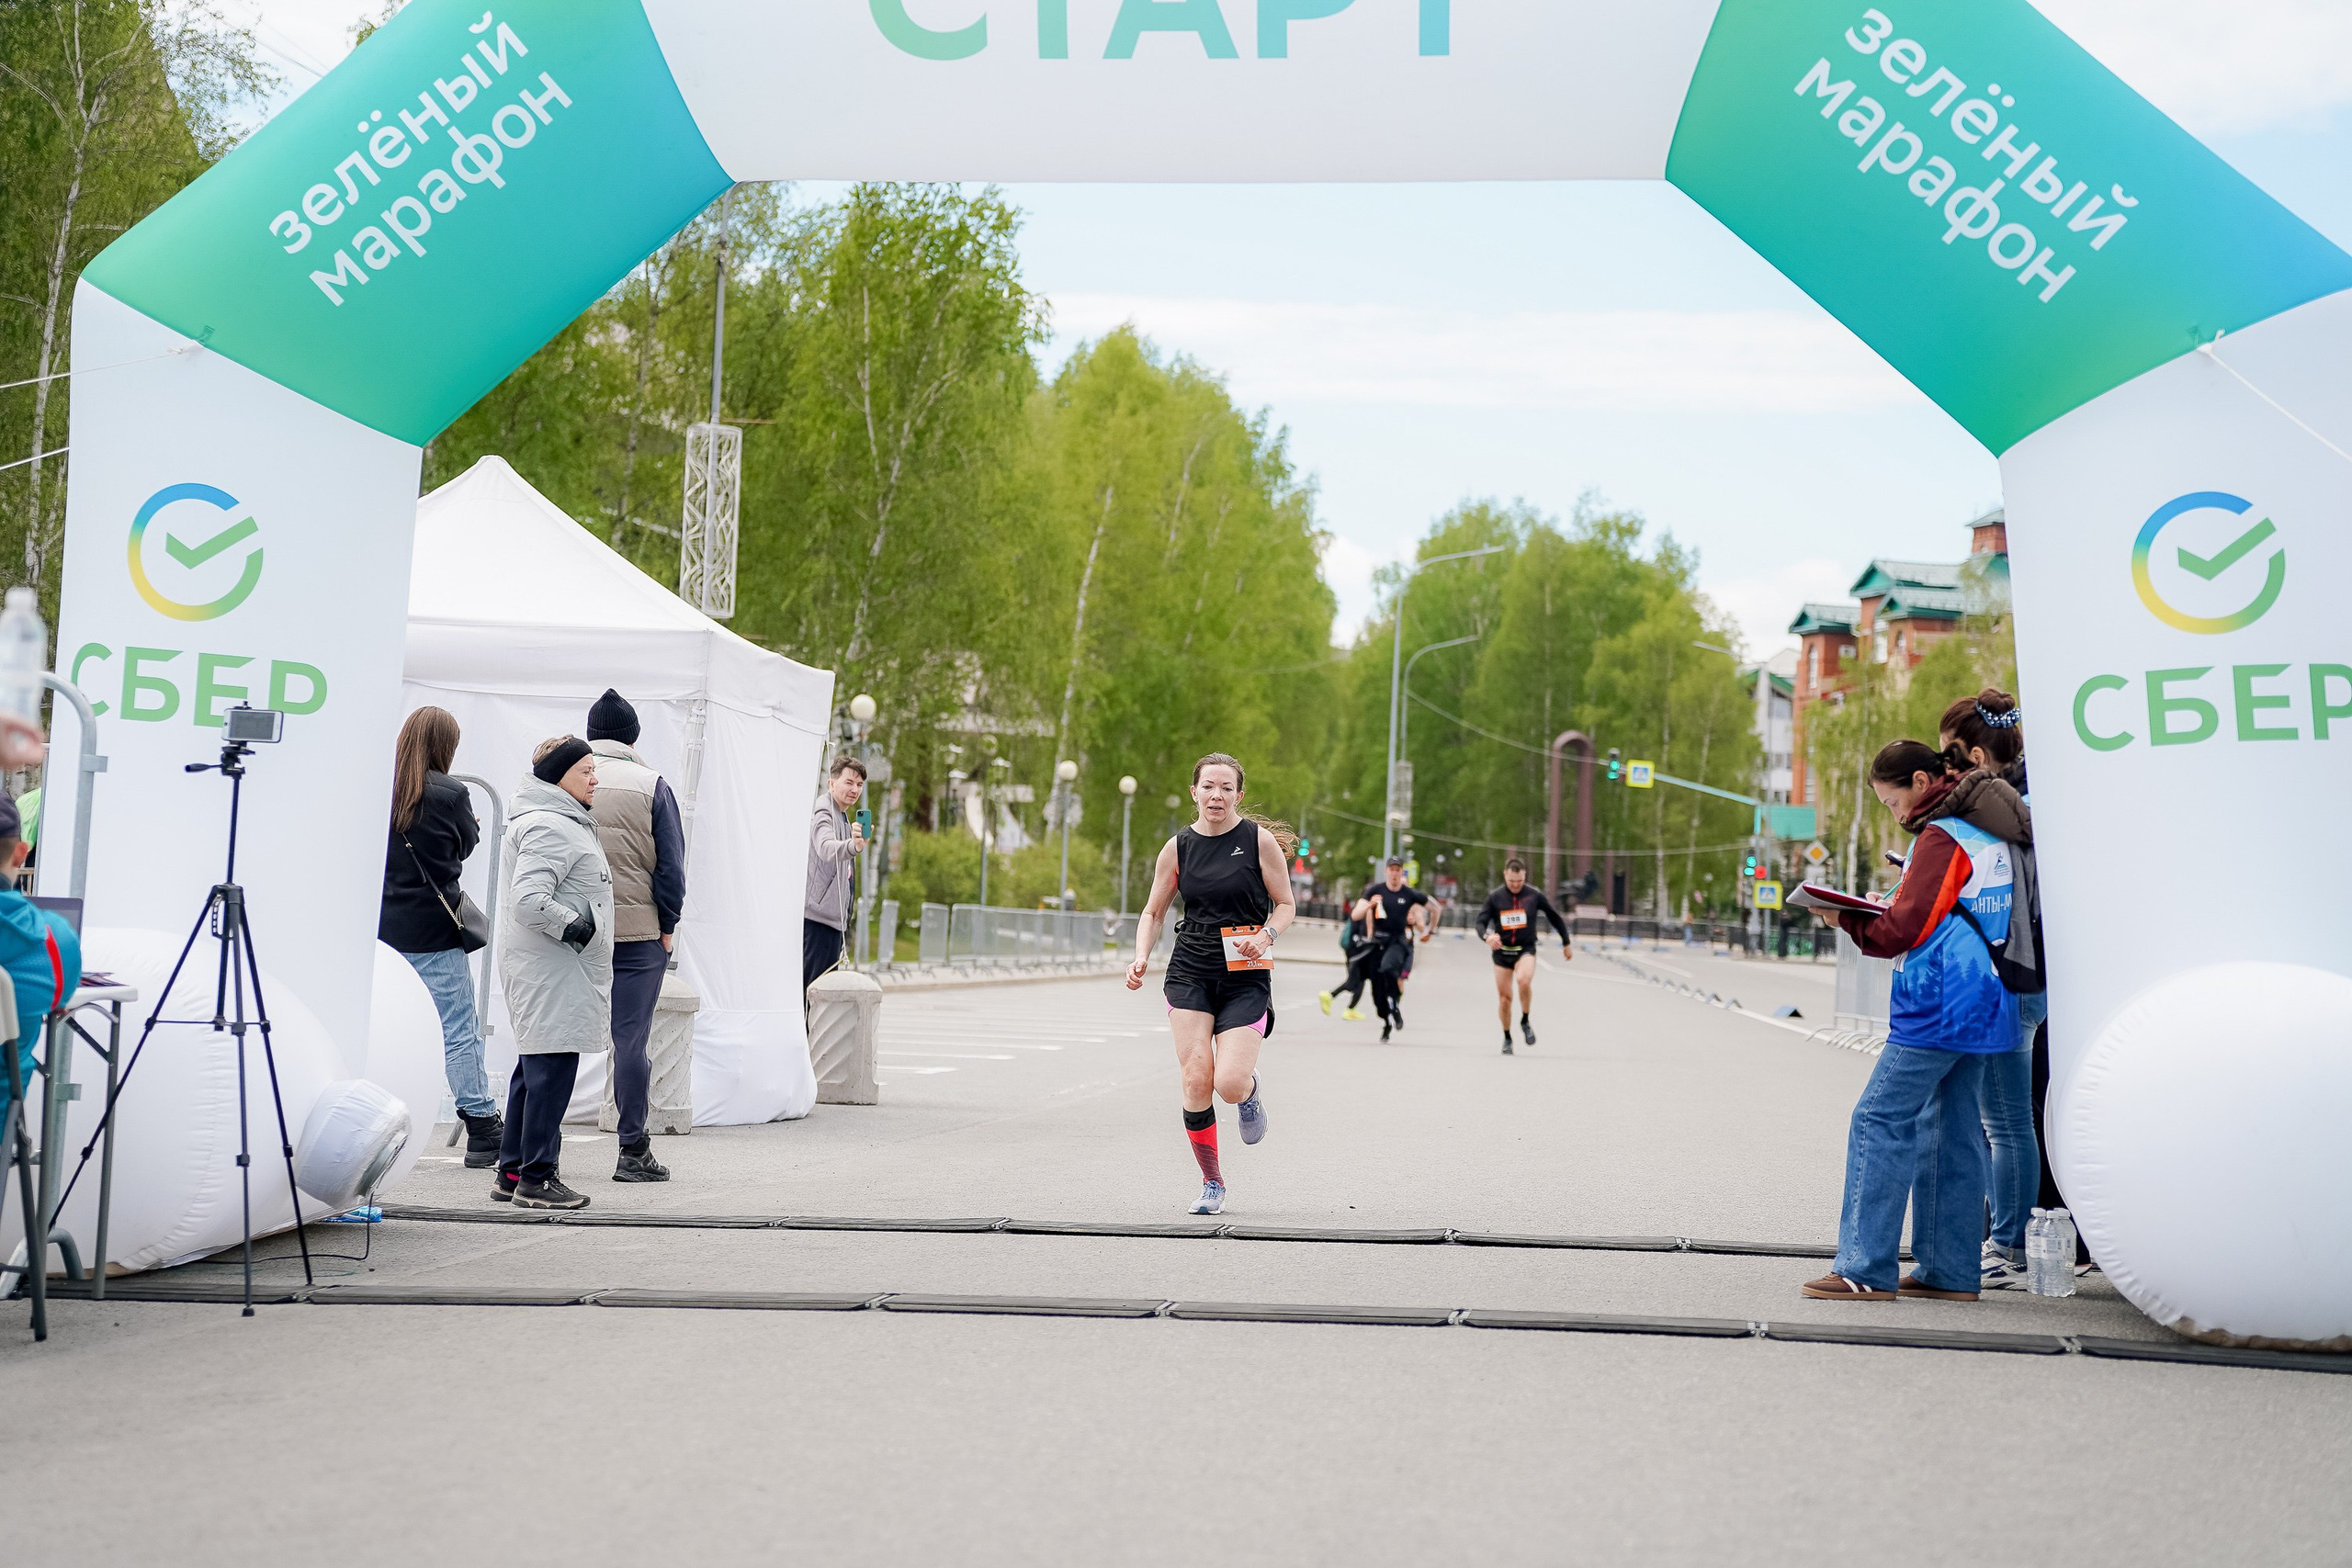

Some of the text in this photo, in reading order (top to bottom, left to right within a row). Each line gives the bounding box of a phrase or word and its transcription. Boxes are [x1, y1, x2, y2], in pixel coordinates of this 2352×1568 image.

[269, 10, 529, 254] зелёный
[309, 71, 573, 307] марафон
[1793, 57, 2077, 304] марафон
[1844, 8, 2140, 252] зелёный
[71, 642, 327, 728] СБЕР
[2073, 663, 2352, 751] СБЕР
[1970, 893, 2012, 914] АНТЫ-М
